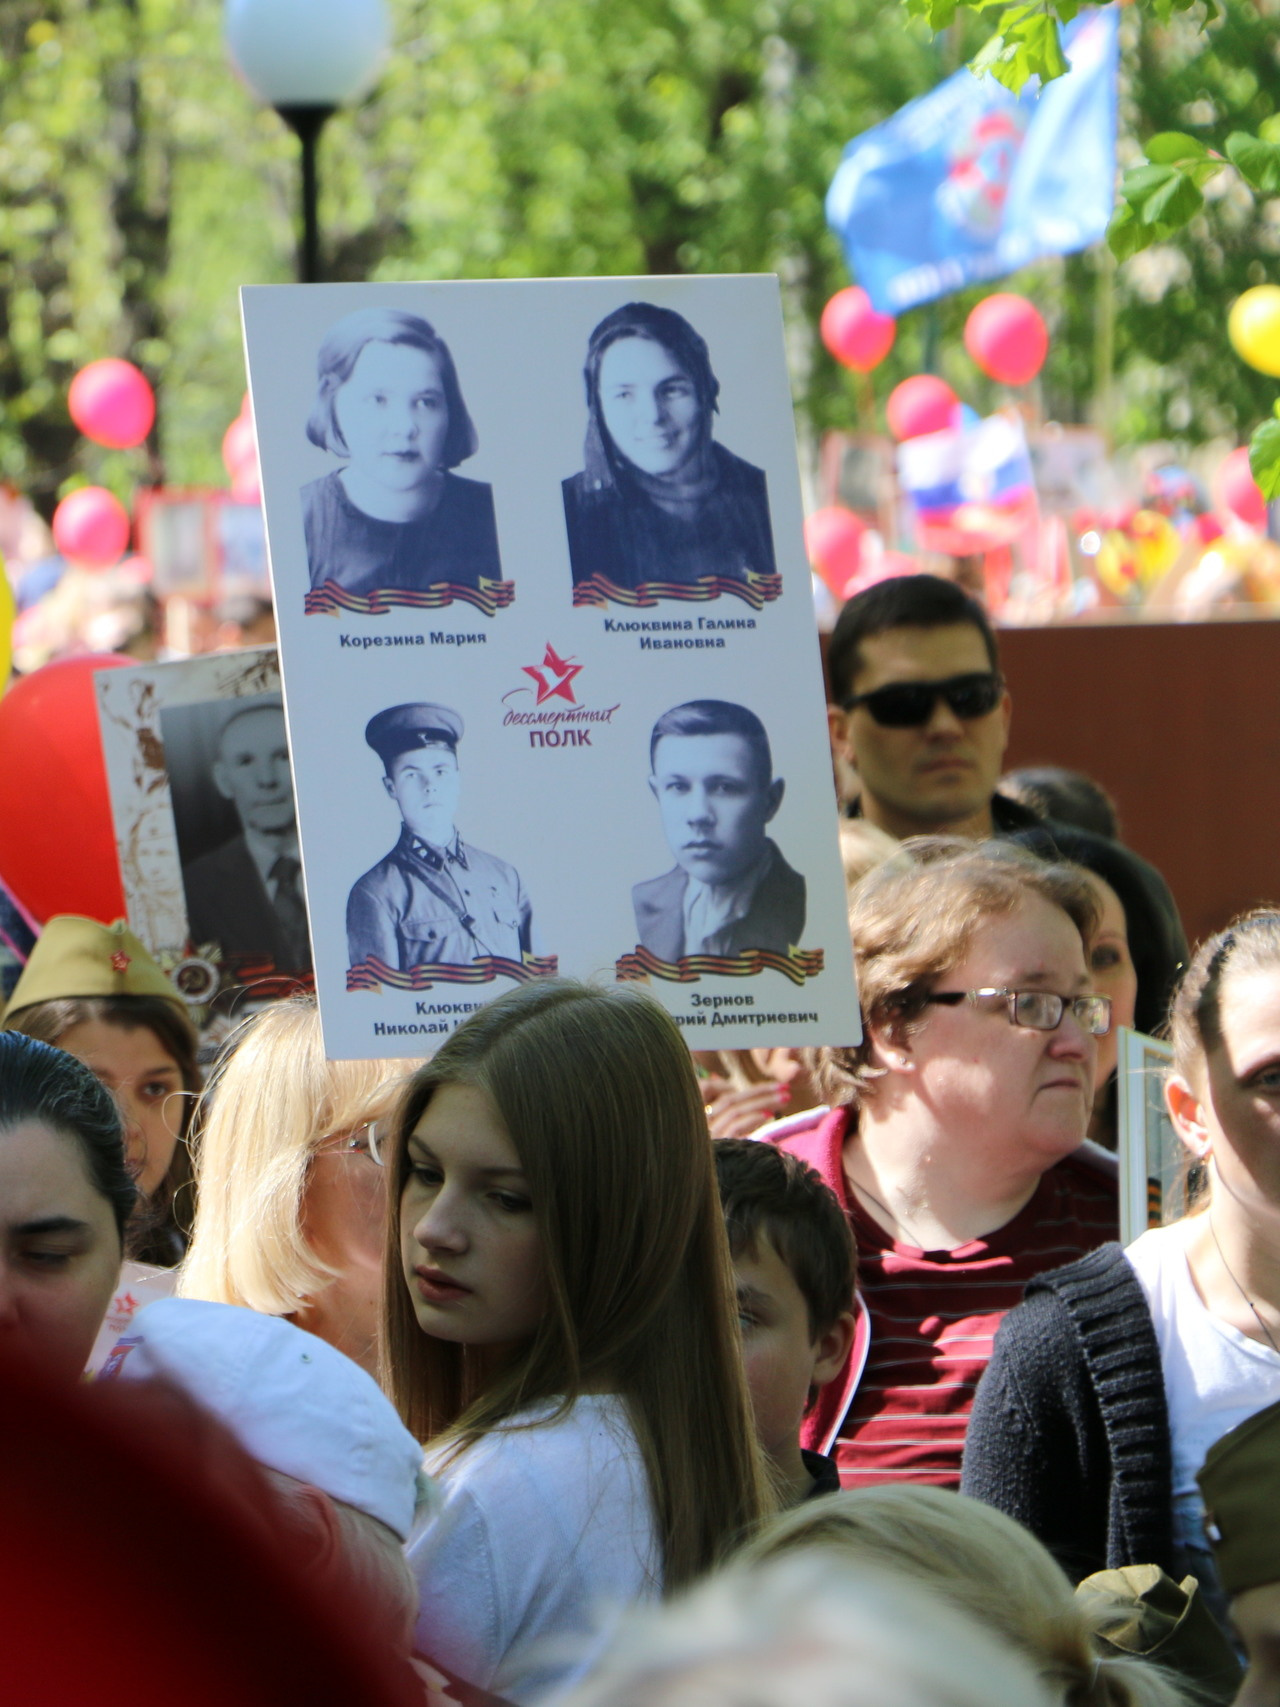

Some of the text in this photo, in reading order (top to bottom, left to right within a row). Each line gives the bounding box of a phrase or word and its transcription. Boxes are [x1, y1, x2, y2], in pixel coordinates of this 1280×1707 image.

[604, 616, 757, 632] Клюквина Галина
[339, 631, 487, 649] Корезина Мария
[639, 636, 726, 650] Ивановна
[529, 729, 593, 748] ПОЛК
[690, 993, 755, 1009] Зернов
[373, 1018, 449, 1036] Николай
[671, 1011, 819, 1027] рий Дмитриевич
